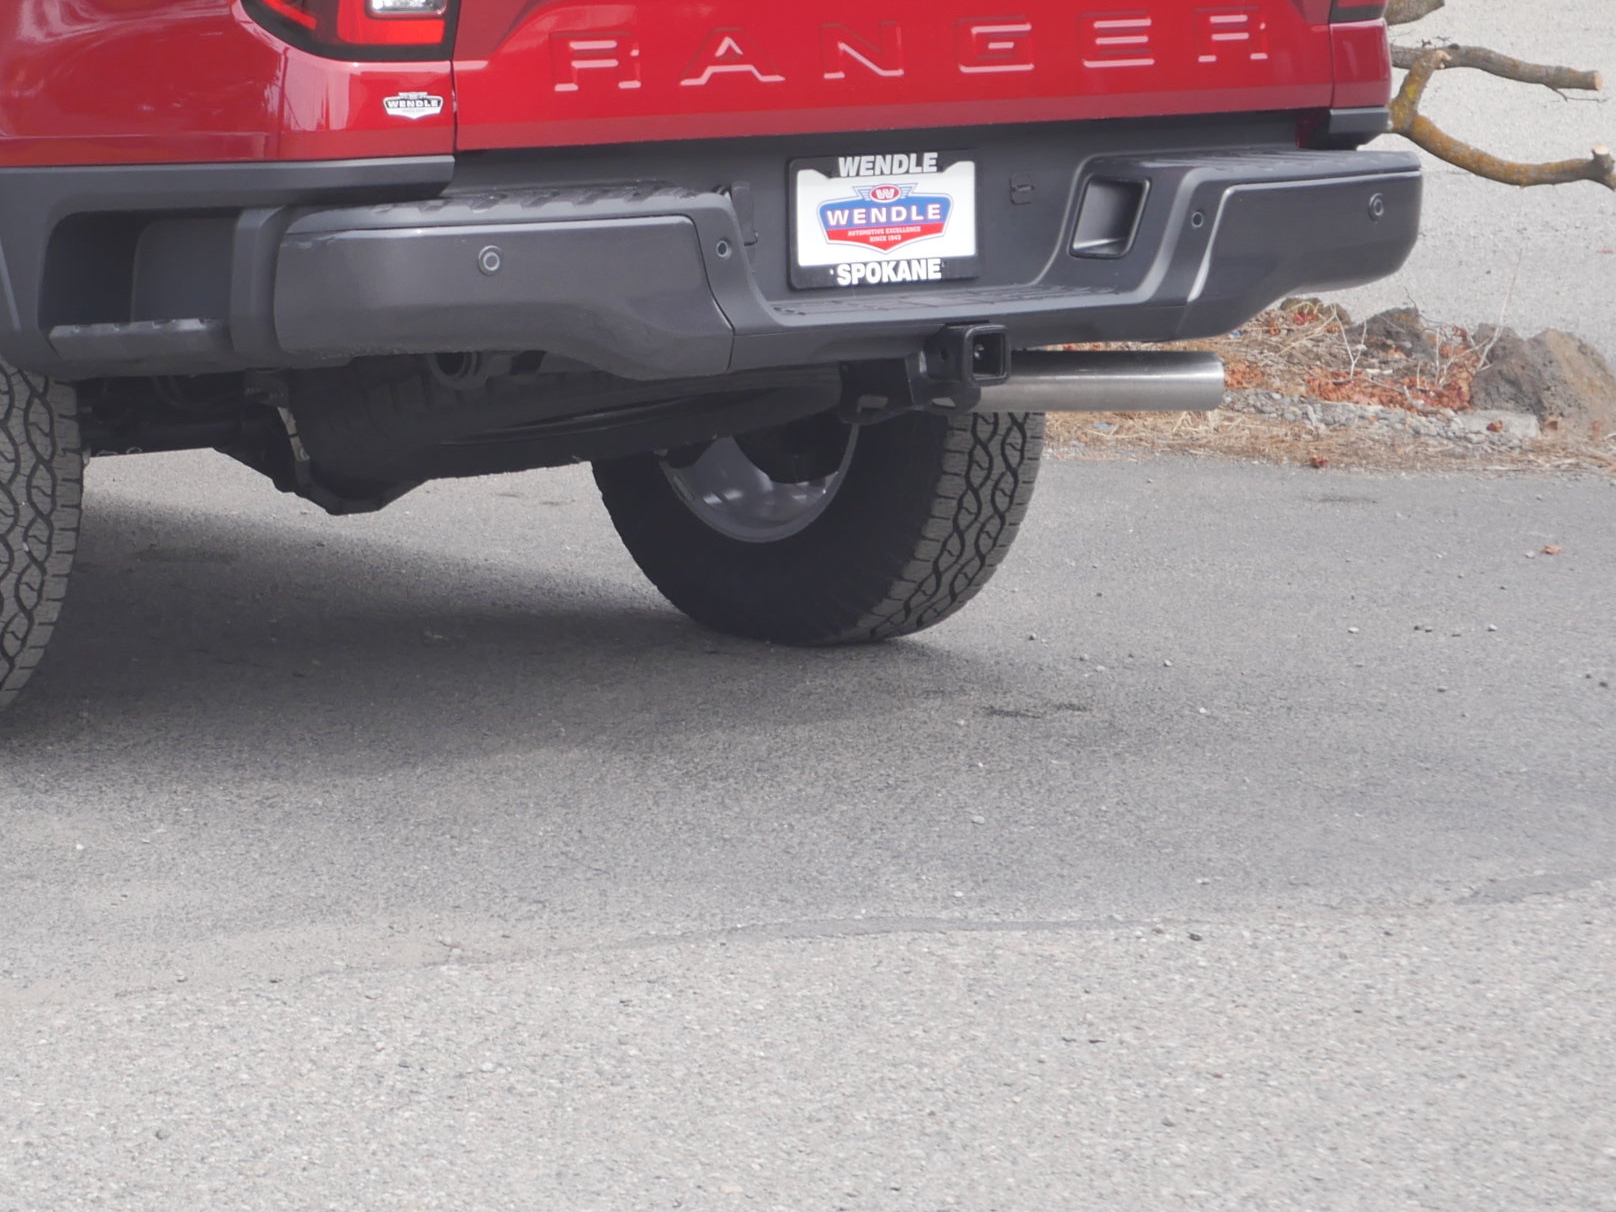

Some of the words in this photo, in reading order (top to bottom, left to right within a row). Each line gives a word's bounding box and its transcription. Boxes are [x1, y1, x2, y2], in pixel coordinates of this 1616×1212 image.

[549, 5, 1270, 92] RANGER
[386, 99, 439, 108] WENDLE
[838, 152, 938, 177] WENDLE
[826, 204, 941, 226] WENDLE
[848, 227, 884, 236] AUTOMOTIVE
[886, 225, 921, 234] EXCELLENCE
[837, 259, 942, 286] SPOKANE
